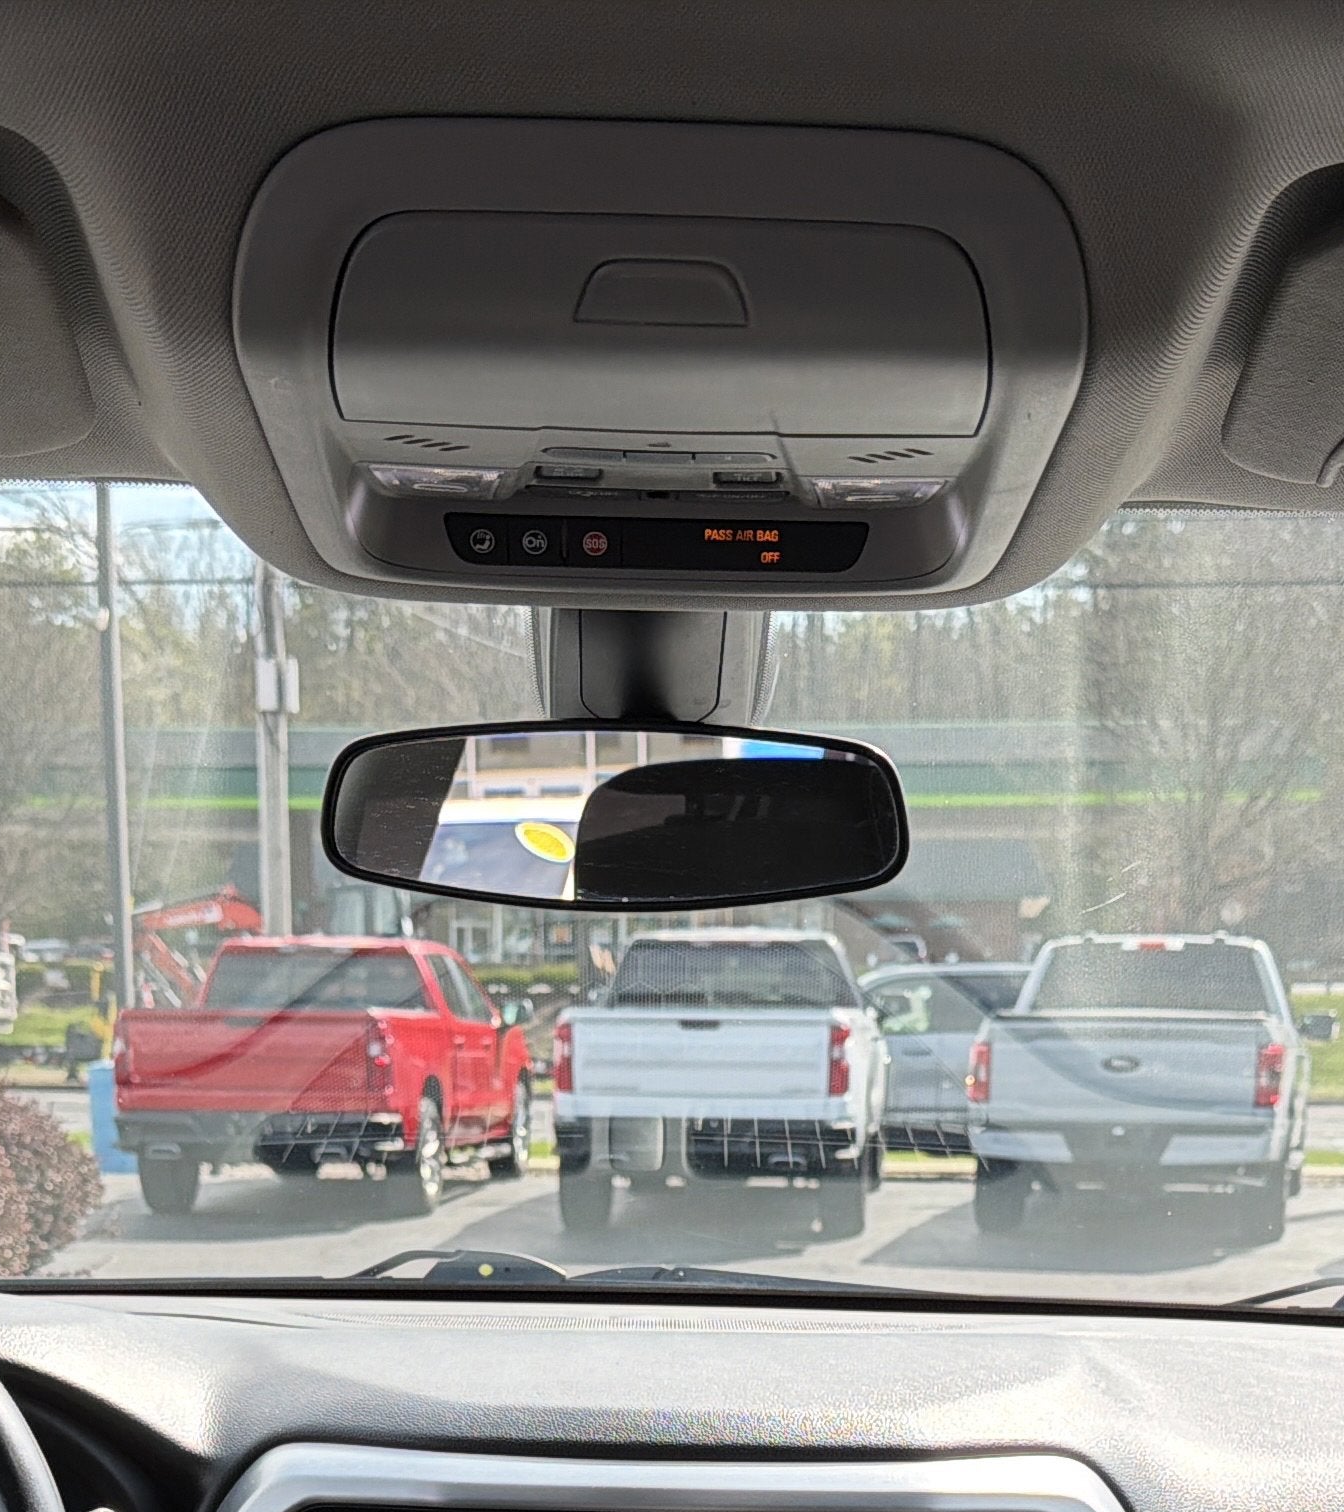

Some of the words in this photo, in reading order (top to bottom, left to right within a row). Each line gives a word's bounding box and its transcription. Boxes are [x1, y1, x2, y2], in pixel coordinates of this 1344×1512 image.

[704, 528, 733, 542] PASS
[735, 529, 754, 542] AIR
[756, 529, 779, 542] BAG
[585, 538, 607, 549] SOS
[760, 551, 781, 563] OFF
